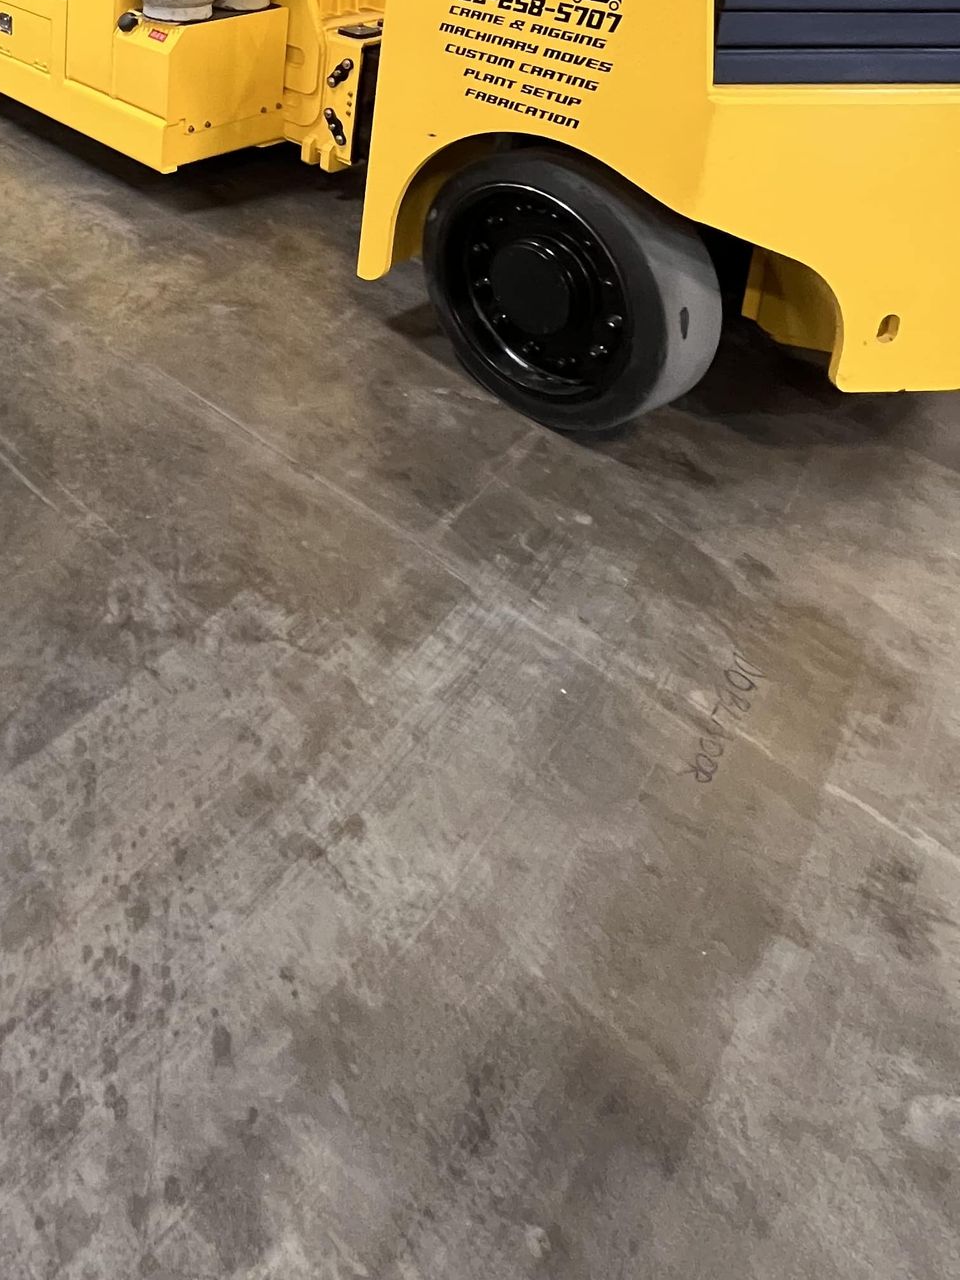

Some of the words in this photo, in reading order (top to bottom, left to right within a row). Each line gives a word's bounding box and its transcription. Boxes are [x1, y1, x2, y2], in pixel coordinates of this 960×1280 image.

[439, 22, 539, 54] MACHINARY
[542, 47, 613, 72] MOVES
[449, 5, 505, 25] CRANE
[509, 19, 525, 31] &
[530, 24, 607, 49] RIGGING
[445, 43, 515, 68] CUSTOM
[519, 62, 599, 91] CRATING
[463, 68, 517, 89] PLANT
[520, 84, 582, 106] SETUP
[464, 88, 580, 129] FABRICATION
